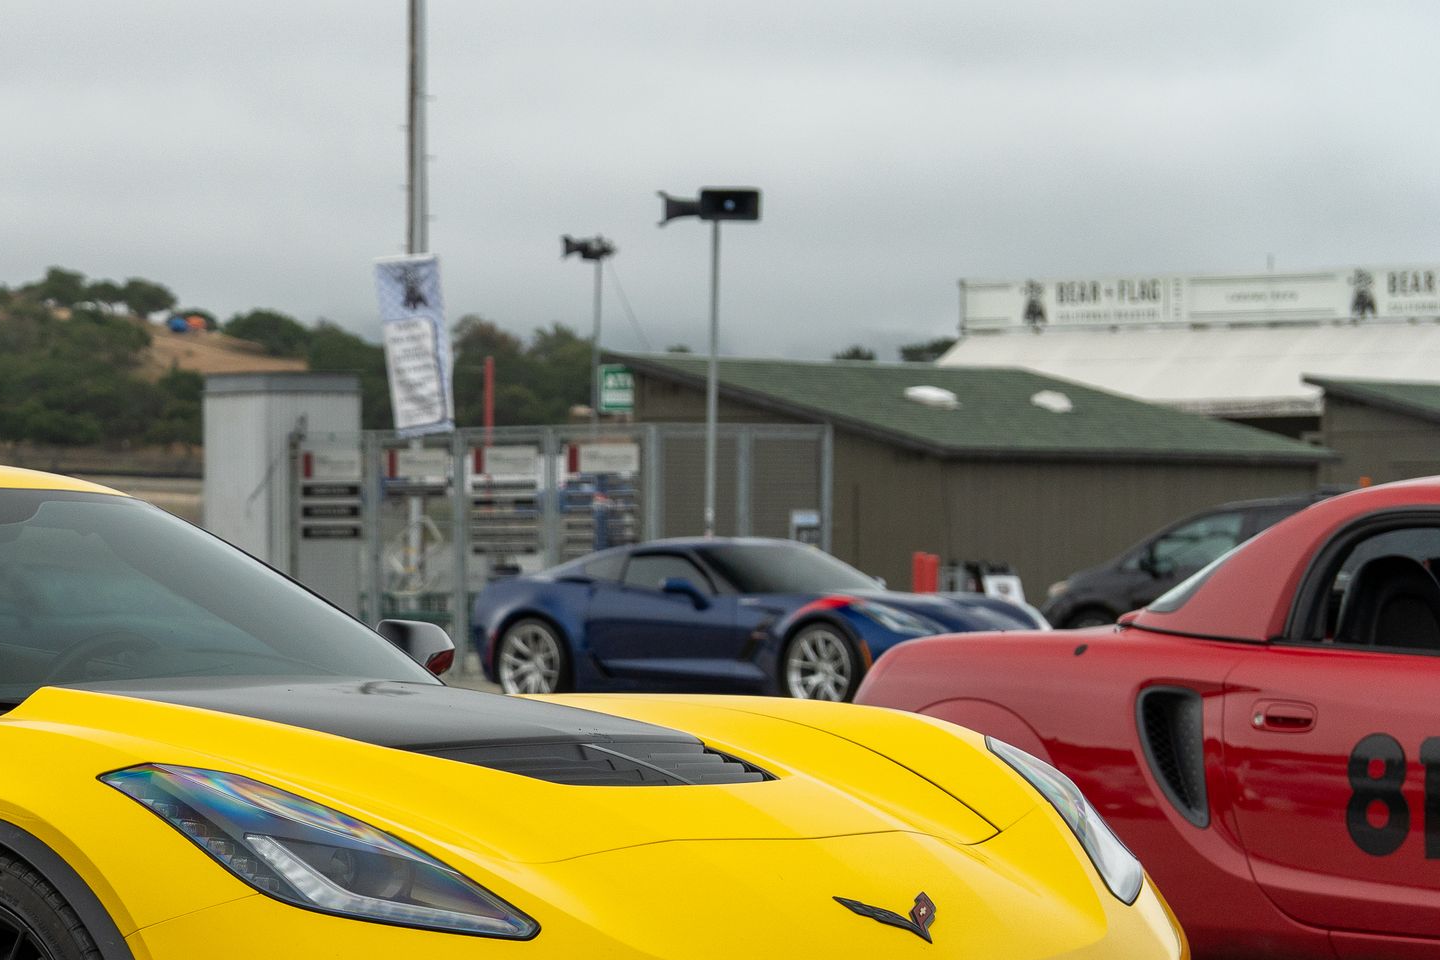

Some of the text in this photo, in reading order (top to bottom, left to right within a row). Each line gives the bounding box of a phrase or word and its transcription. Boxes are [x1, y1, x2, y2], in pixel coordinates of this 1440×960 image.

[1056, 280, 1101, 304] BEAR
[1117, 278, 1160, 302] FLAG
[1346, 732, 1440, 859] 8
